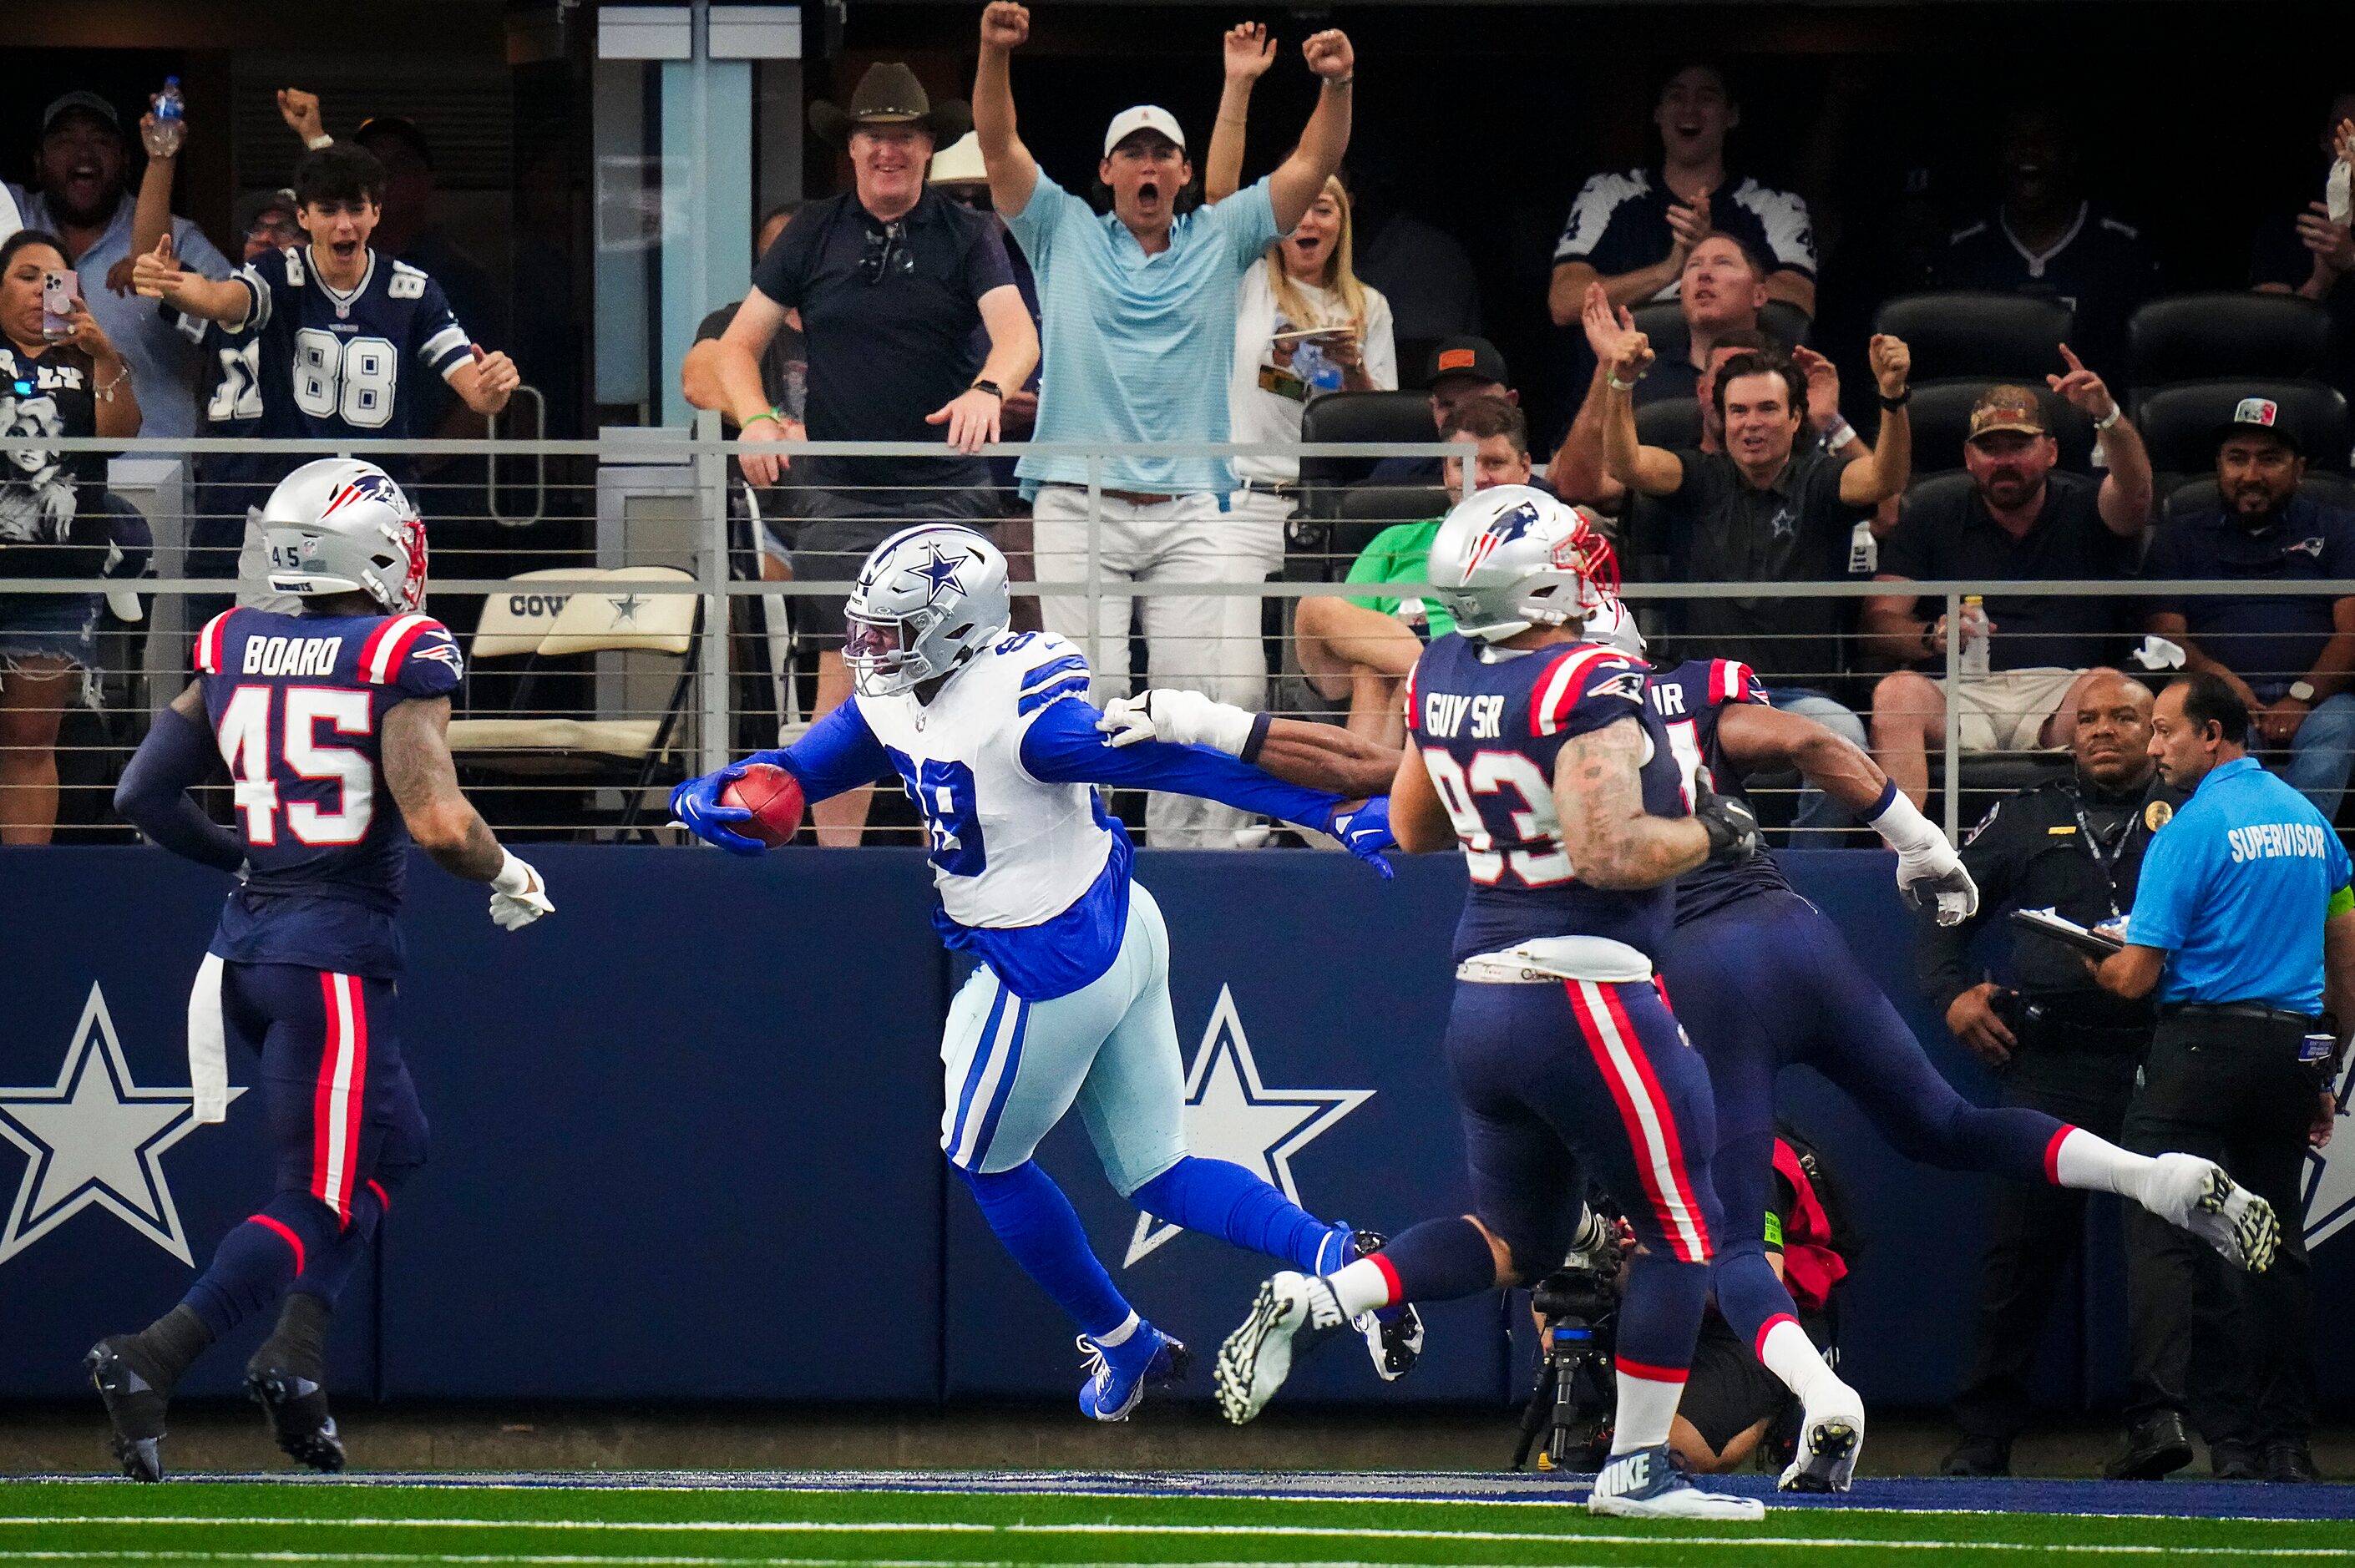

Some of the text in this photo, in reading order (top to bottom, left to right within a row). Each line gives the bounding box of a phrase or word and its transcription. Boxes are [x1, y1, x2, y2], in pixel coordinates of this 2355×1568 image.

[293, 327, 398, 428] 88
[242, 635, 343, 676] BOARD
[1426, 692, 1505, 739] GUY SR
[217, 684, 375, 847] 45
[1421, 746, 1576, 888] 93
[2227, 823, 2326, 863] SUPERVISOR
[1594, 1452, 1651, 1497] NIKE
